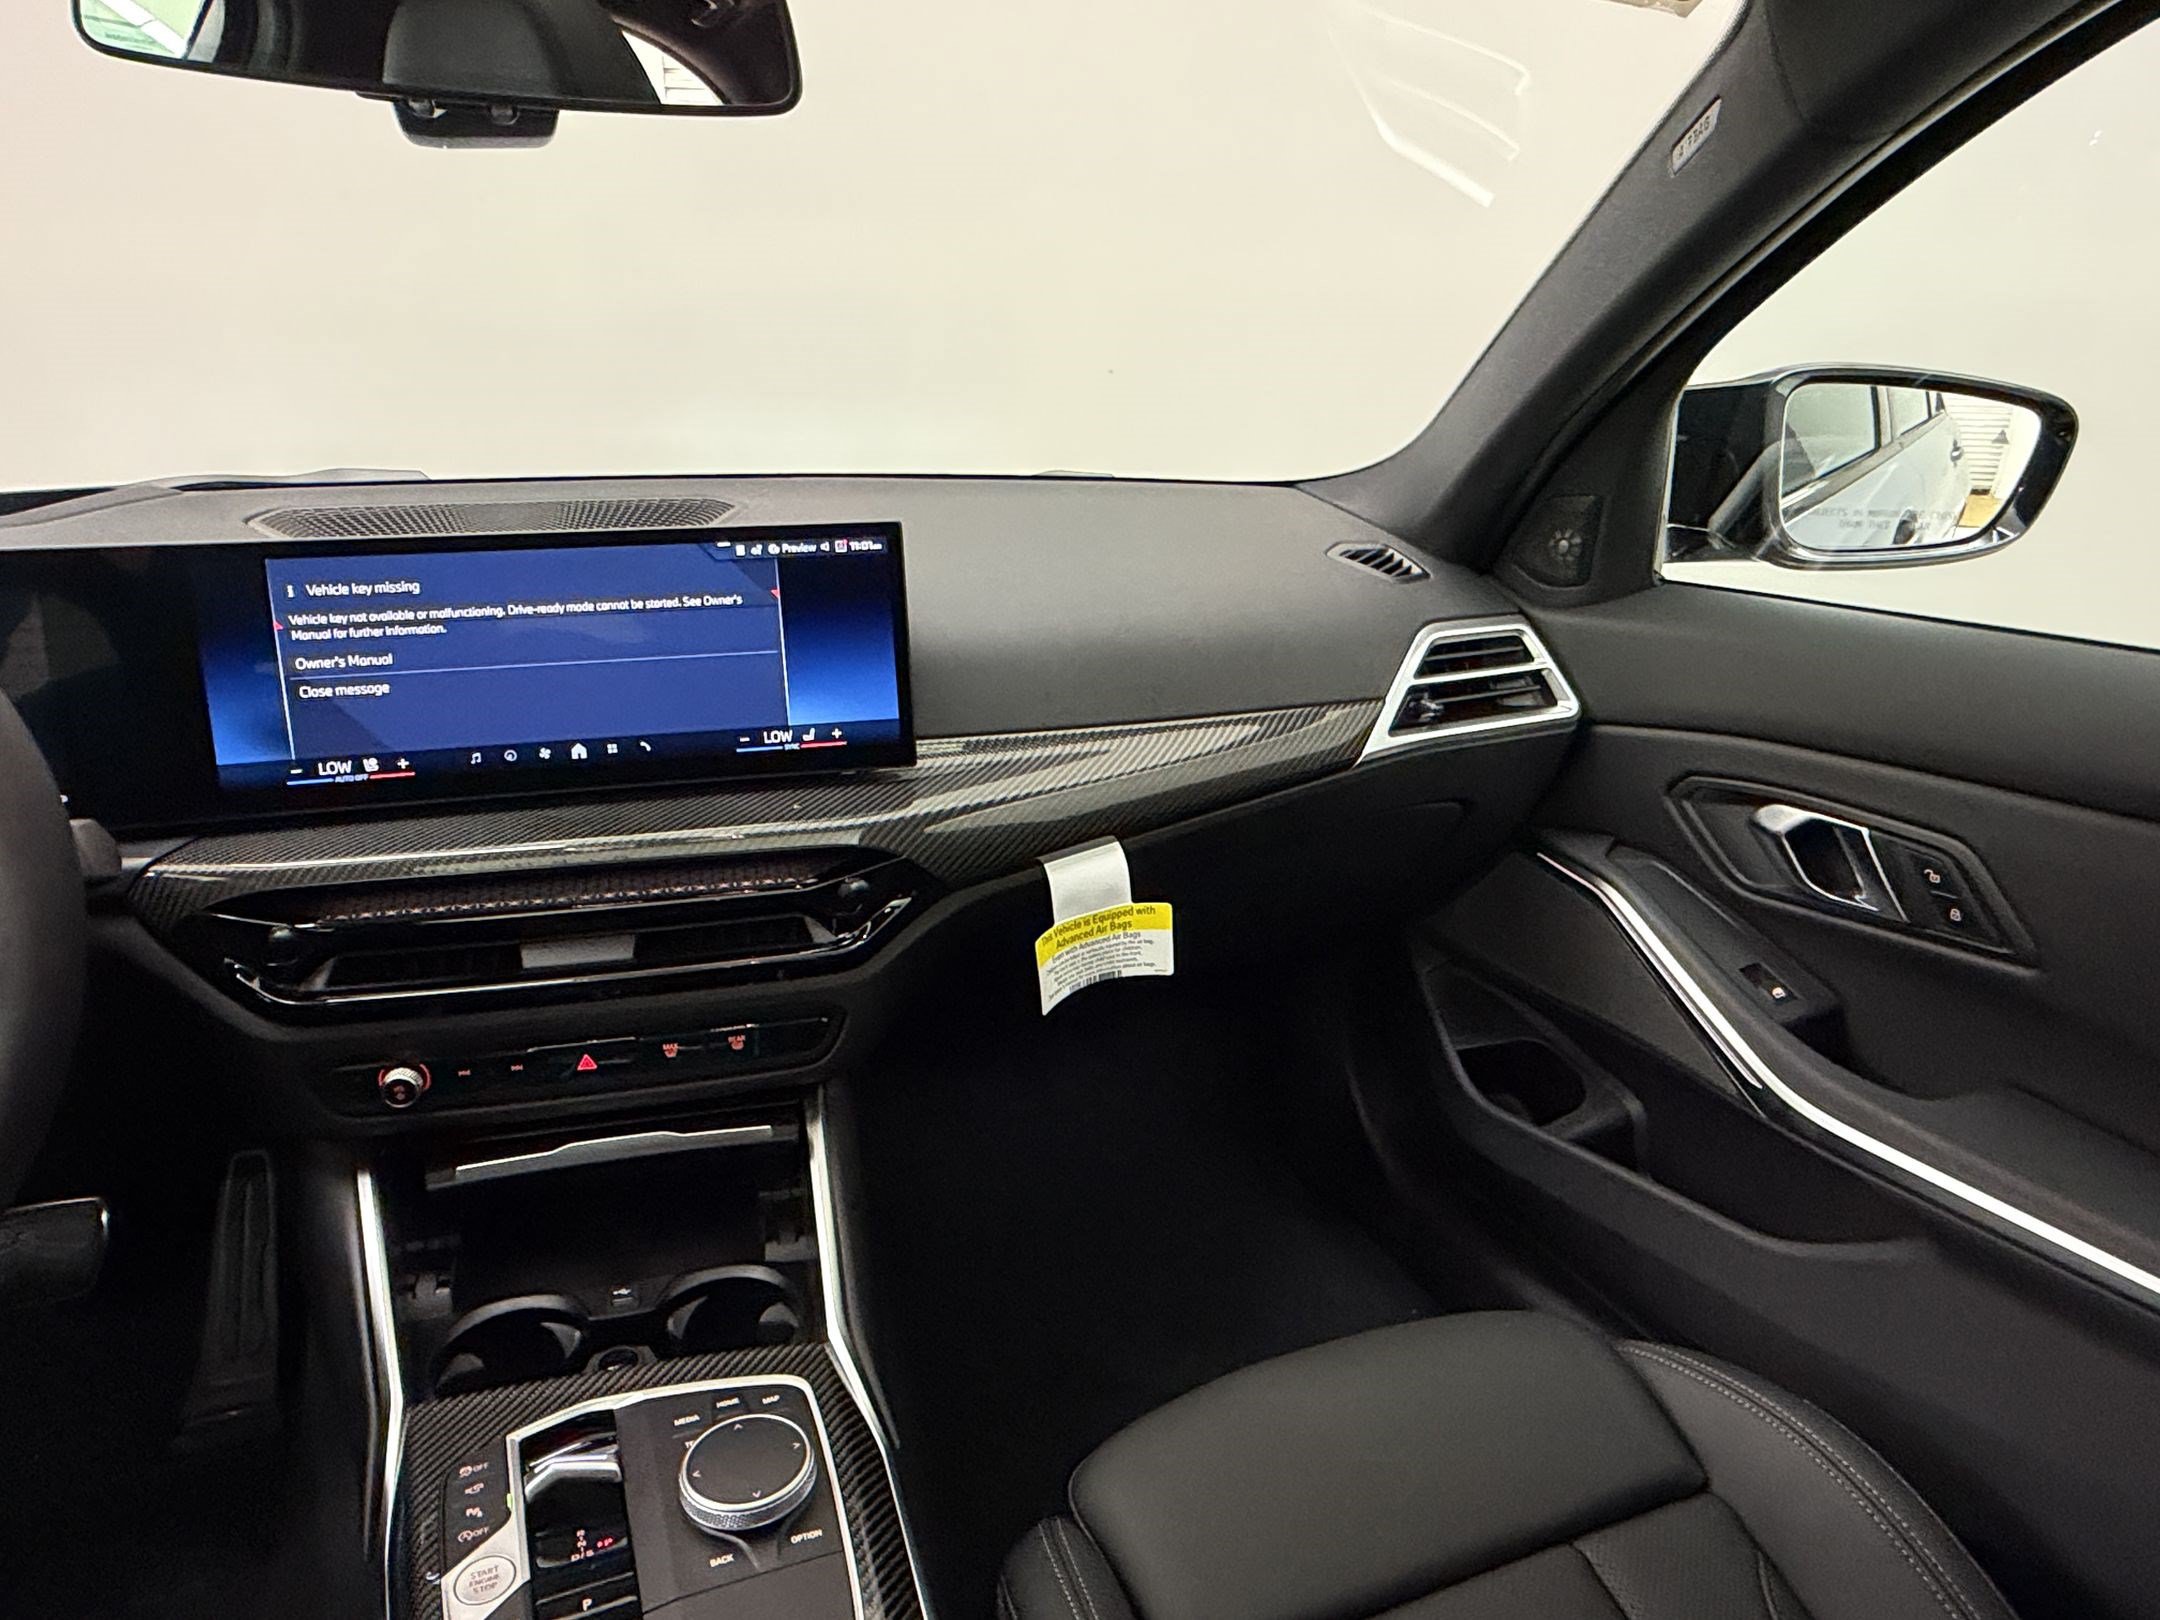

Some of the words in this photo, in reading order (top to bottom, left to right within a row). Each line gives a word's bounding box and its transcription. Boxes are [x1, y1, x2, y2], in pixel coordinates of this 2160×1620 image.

[782, 543, 817, 554] Preview
[305, 584, 349, 596] Vehicle
[351, 583, 372, 596] key
[374, 581, 420, 594] missing
[288, 614, 328, 625] Vehicle
[329, 613, 348, 624] key
[350, 612, 368, 622] not
[368, 610, 415, 621] available
[417, 611, 428, 620] or
[429, 606, 506, 619] malfunctioning.
[507, 602, 565, 615] Drive-ready
[566, 601, 595, 612] mode
[596, 600, 629, 611] cannot
[631, 599, 643, 609] be
[645, 597, 682, 609] started.
[683, 596, 701, 607] See
[703, 594, 743, 606] Owner's
[291, 629, 332, 641] Manual
[333, 628, 348, 639] for
[349, 626, 385, 638] further
[385, 624, 448, 636] information.
[295, 656, 346, 670] Owner's
[347, 653, 394, 667] Manual
[299, 685, 334, 698] Close
[335, 684, 390, 697] message
[763, 729, 793, 744] LOW
[318, 760, 352, 775] LOW
[1053, 919, 1082, 938] Vehicle
[1083, 917, 1091, 926] is
[1092, 906, 1134, 924] Equipped
[1135, 906, 1156, 916] with
[1056, 929, 1094, 950] Advanced
[1095, 924, 1108, 935] Air
[1109, 920, 1133, 933] Bags
[762, 1395, 780, 1405] MAP
[673, 1413, 701, 1427] MEDIA
[790, 1528, 823, 1545] OPTION
[709, 1553, 735, 1568] BACK
[470, 1564, 500, 1578] START
[469, 1574, 501, 1587] ENGINE
[473, 1582, 499, 1595] STOP
[583, 1598, 592, 1612] P
